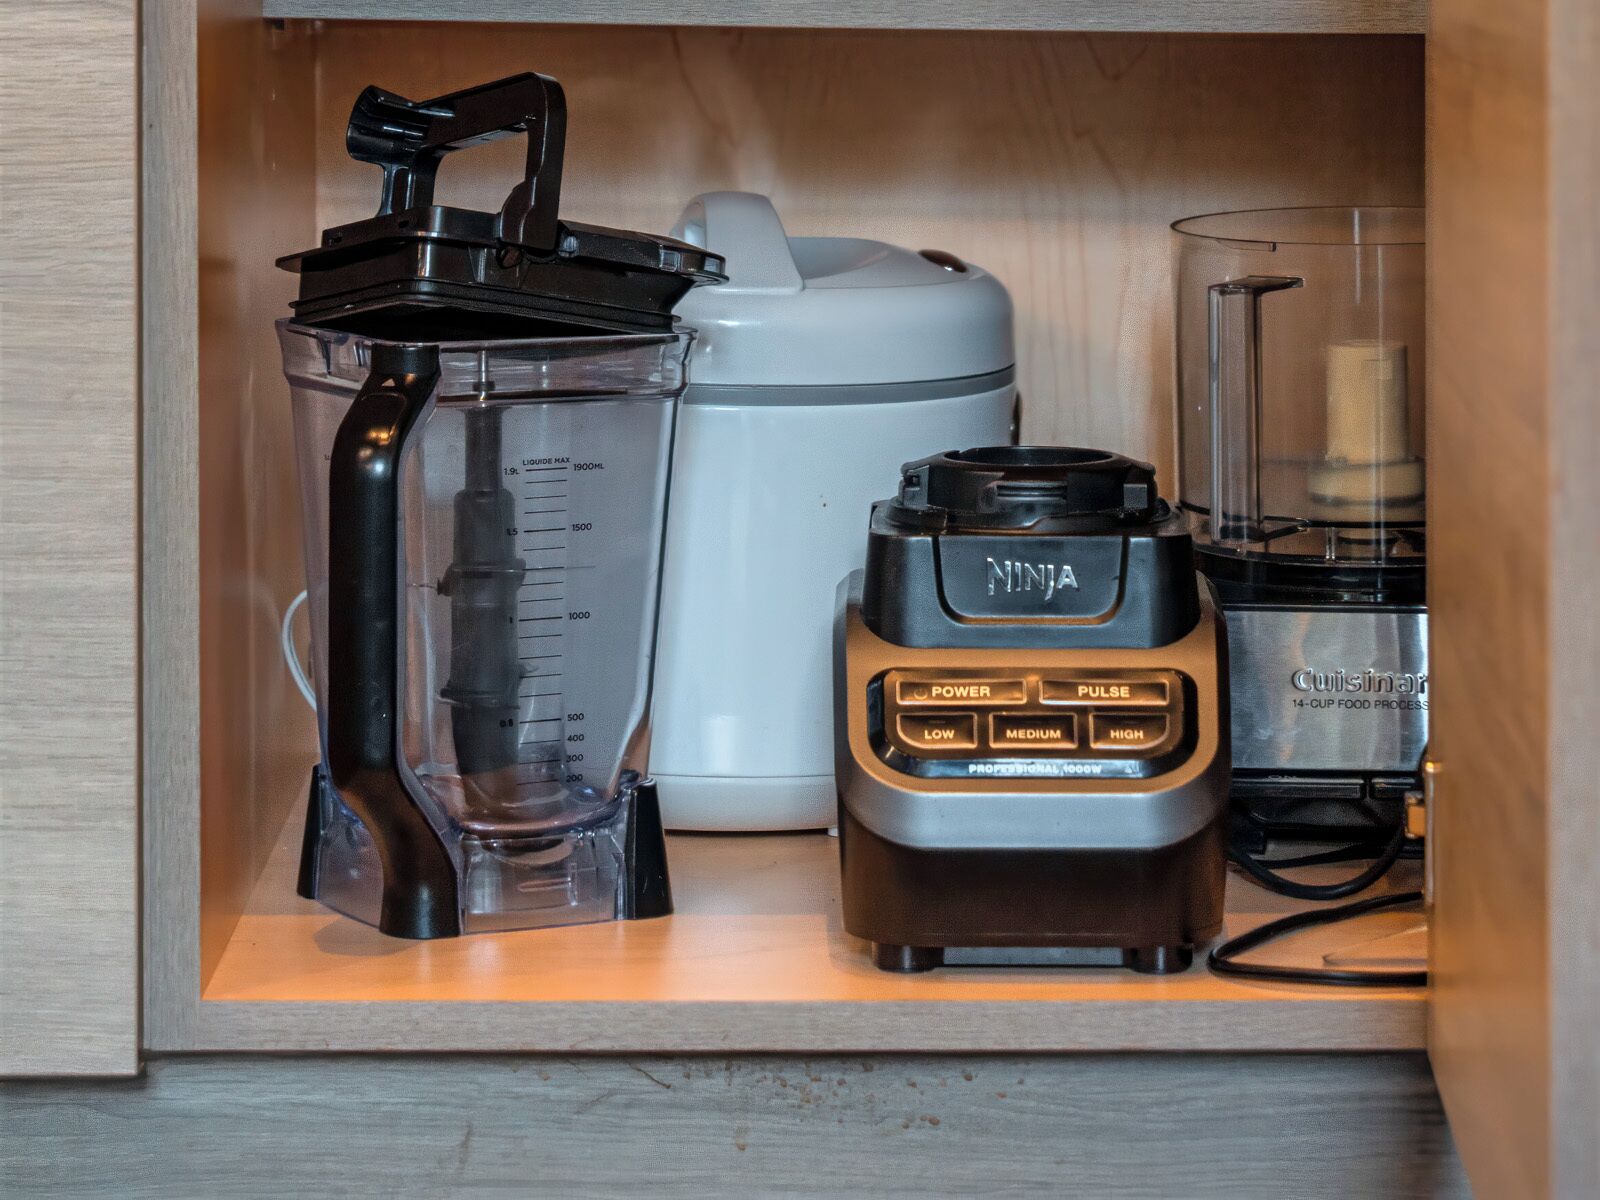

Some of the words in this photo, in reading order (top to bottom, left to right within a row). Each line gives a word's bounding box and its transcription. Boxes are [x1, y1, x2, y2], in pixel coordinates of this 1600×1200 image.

[554, 456, 570, 464] MAX
[573, 462, 605, 471] 1900ML
[571, 522, 593, 532] 1500
[986, 556, 1080, 600] NINJA
[568, 611, 591, 620] 1000
[931, 685, 991, 698] POWER
[1077, 685, 1130, 698] PULSE
[1292, 698, 1335, 709] 14-CUP
[1338, 699, 1371, 710] FOOD
[567, 712, 585, 721] 500
[567, 733, 585, 742] 400
[924, 729, 955, 740] LOW
[1006, 729, 1061, 740] MEDIUM
[1110, 729, 1144, 740] HIGH
[565, 754, 584, 763] 300
[968, 763, 1060, 774] PROFESSIONAL
[1063, 764, 1103, 774] 1000W
[566, 773, 584, 783] 200
